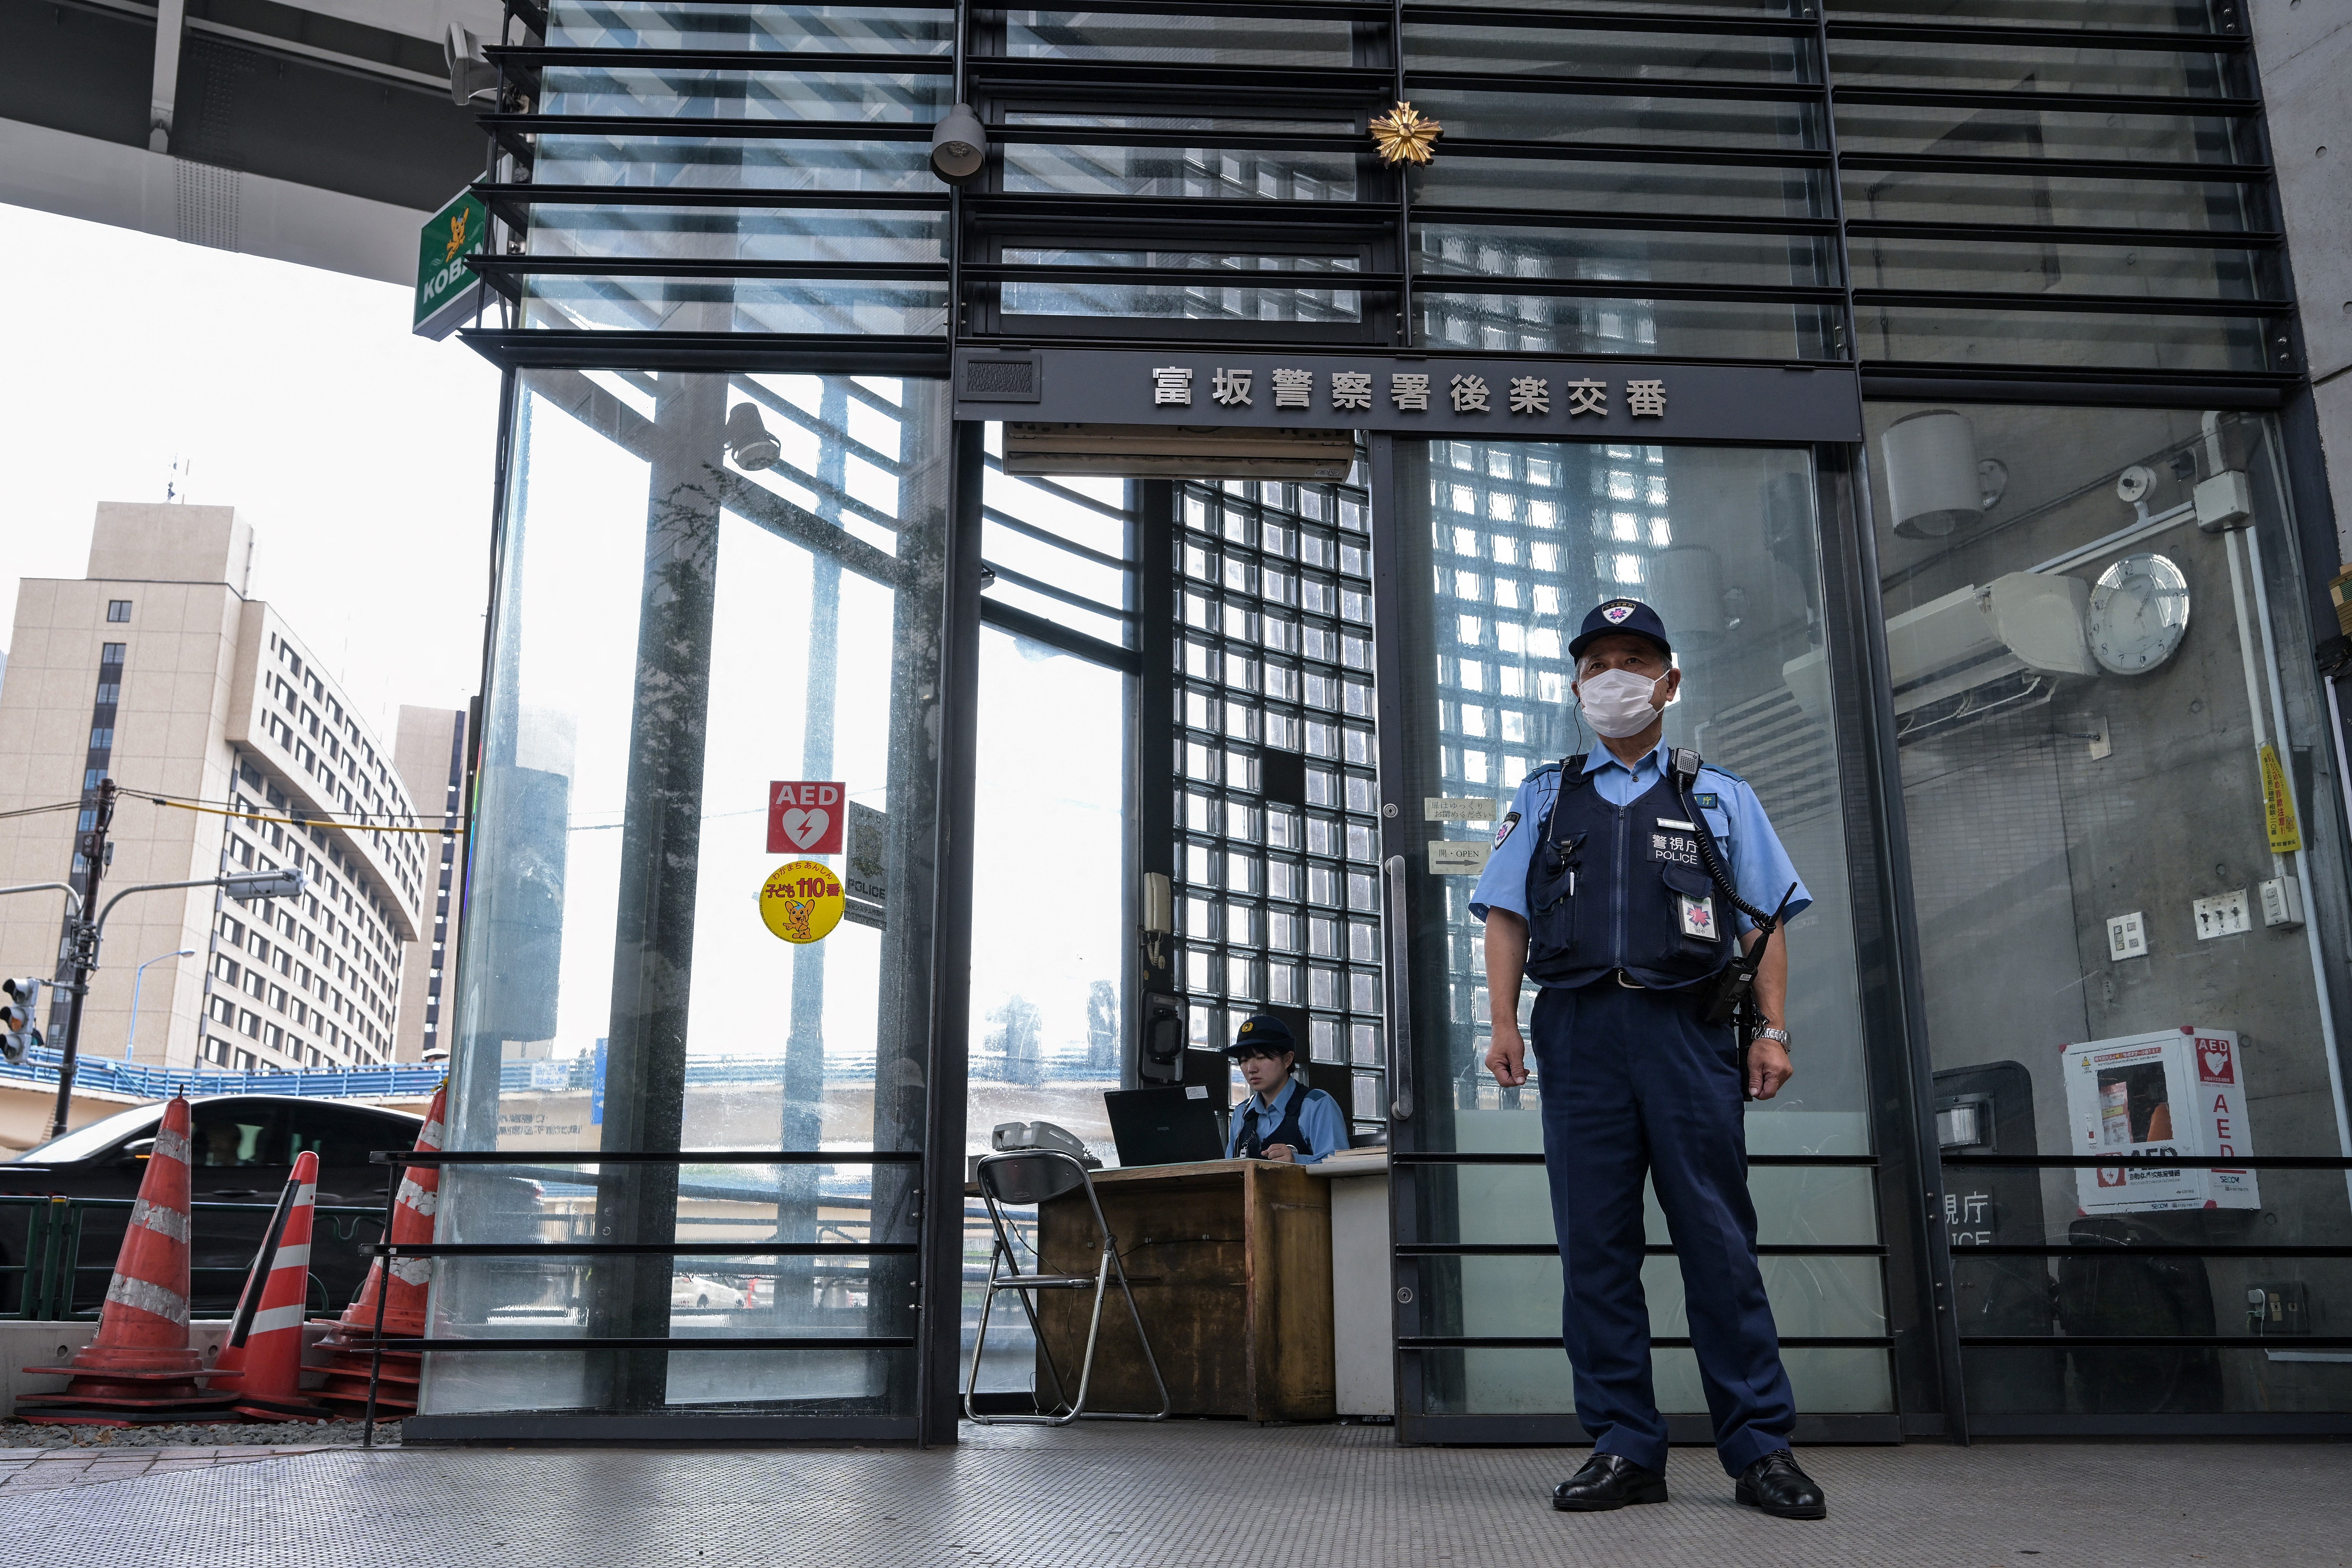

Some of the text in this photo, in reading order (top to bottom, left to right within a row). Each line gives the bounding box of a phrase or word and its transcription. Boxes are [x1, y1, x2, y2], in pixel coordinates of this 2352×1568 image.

[1153, 366, 1667, 417] 富坂警察署後楽交番
[2101, 642, 2108, 656] 8
[2118, 653, 2124, 666] 7
[775, 785, 838, 805] AED
[1694, 796, 1712, 805] 庁
[1431, 801, 1483, 810] 扉はゆっくり
[1652, 834, 1699, 854] 警視庁
[1656, 850, 1698, 865] POLICE
[765, 877, 840, 898] 子ども110番
[847, 878, 885, 900] POLICE
[2198, 1039, 2228, 1052] AED
